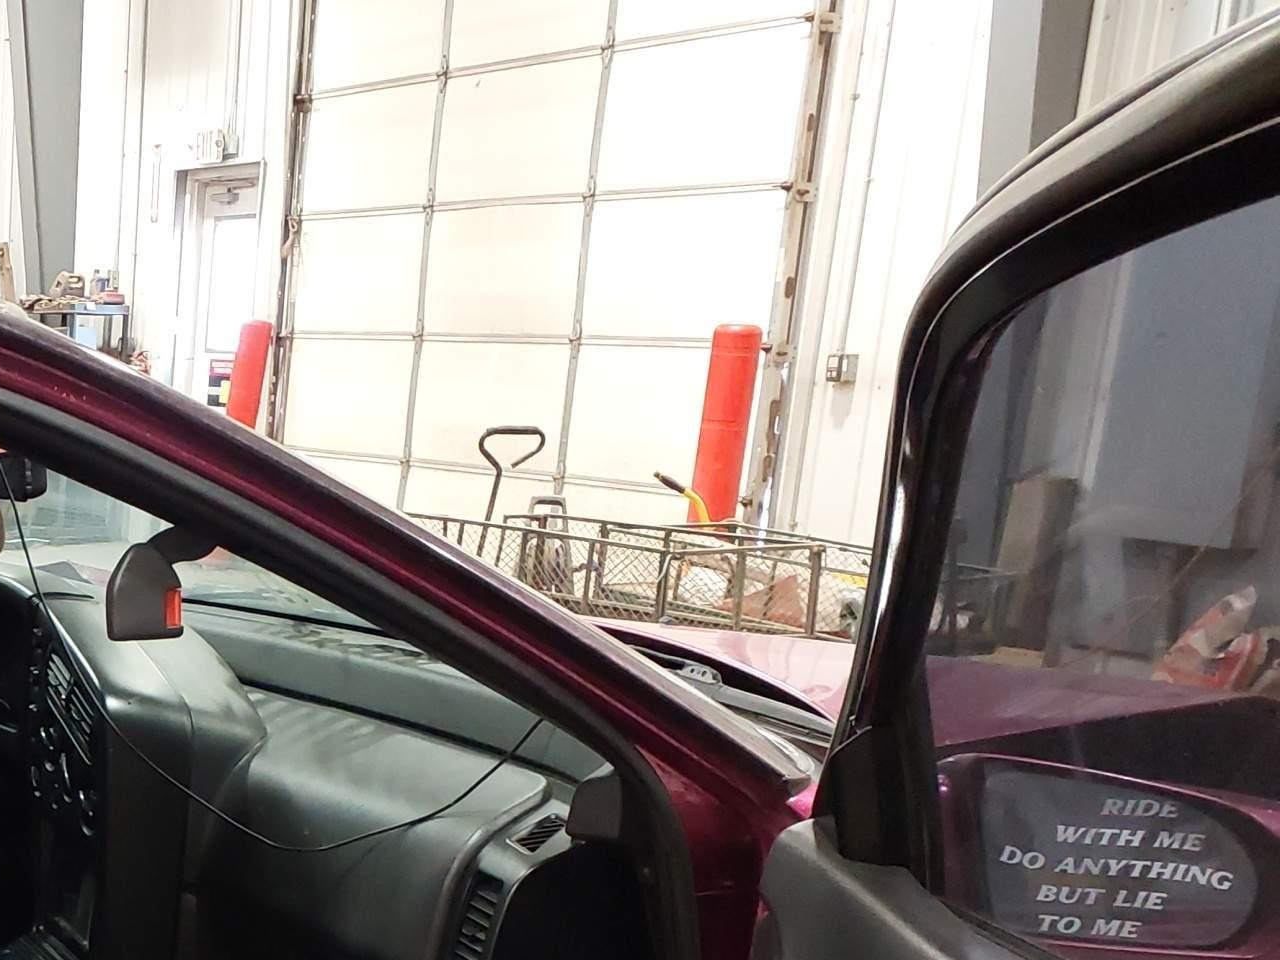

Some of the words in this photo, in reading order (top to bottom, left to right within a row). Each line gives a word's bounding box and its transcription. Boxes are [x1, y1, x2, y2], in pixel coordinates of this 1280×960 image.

[1100, 798, 1178, 818] RIDE
[1056, 825, 1146, 848] WITH
[1153, 832, 1206, 851] ME
[1000, 845, 1045, 870] DO
[1054, 857, 1234, 890] ANYTHING
[1036, 884, 1106, 905] BUT
[1113, 890, 1168, 910] LIE
[1037, 914, 1081, 933] TO
[1091, 919, 1142, 938] ME
